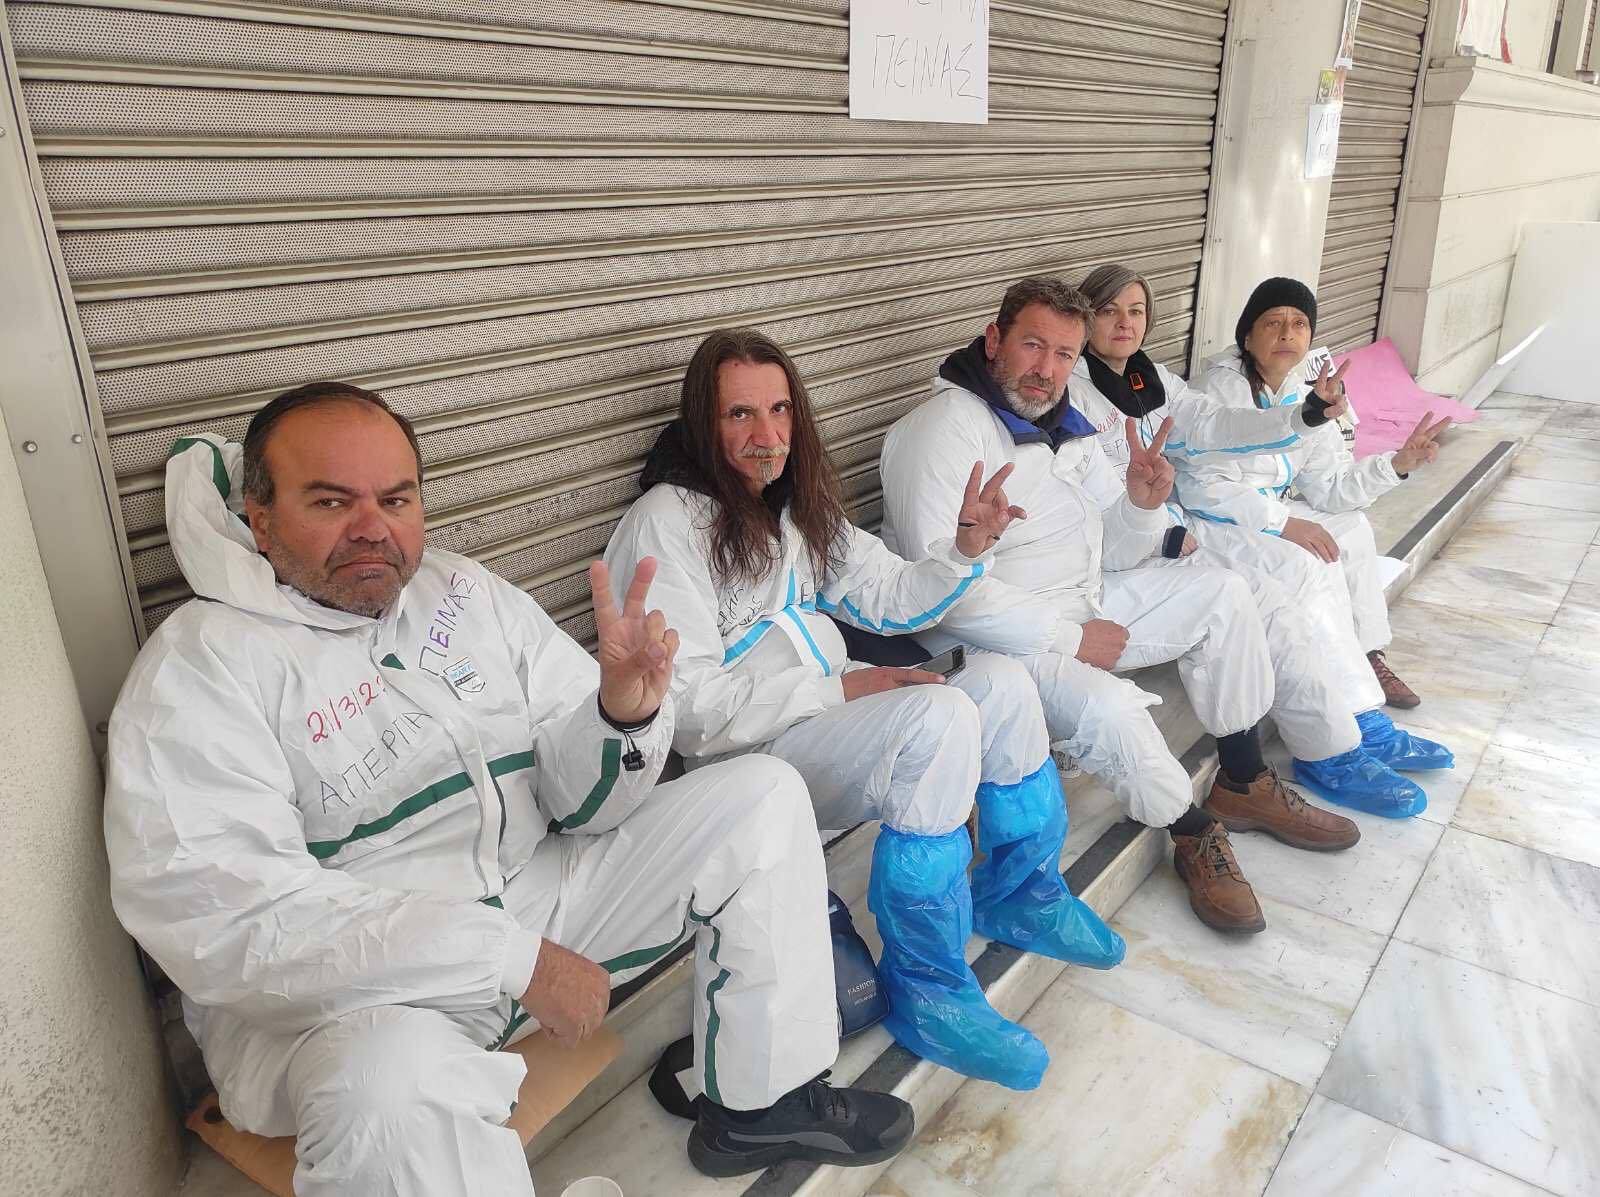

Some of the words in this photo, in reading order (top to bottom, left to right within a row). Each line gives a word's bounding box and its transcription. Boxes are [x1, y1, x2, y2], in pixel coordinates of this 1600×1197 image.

[871, 32, 985, 100] ΠΕΙΝΑΣ
[418, 571, 477, 677] ΠΕΙΝΑΣ
[319, 710, 433, 815] ΑΠΕΡΓΙΑ
